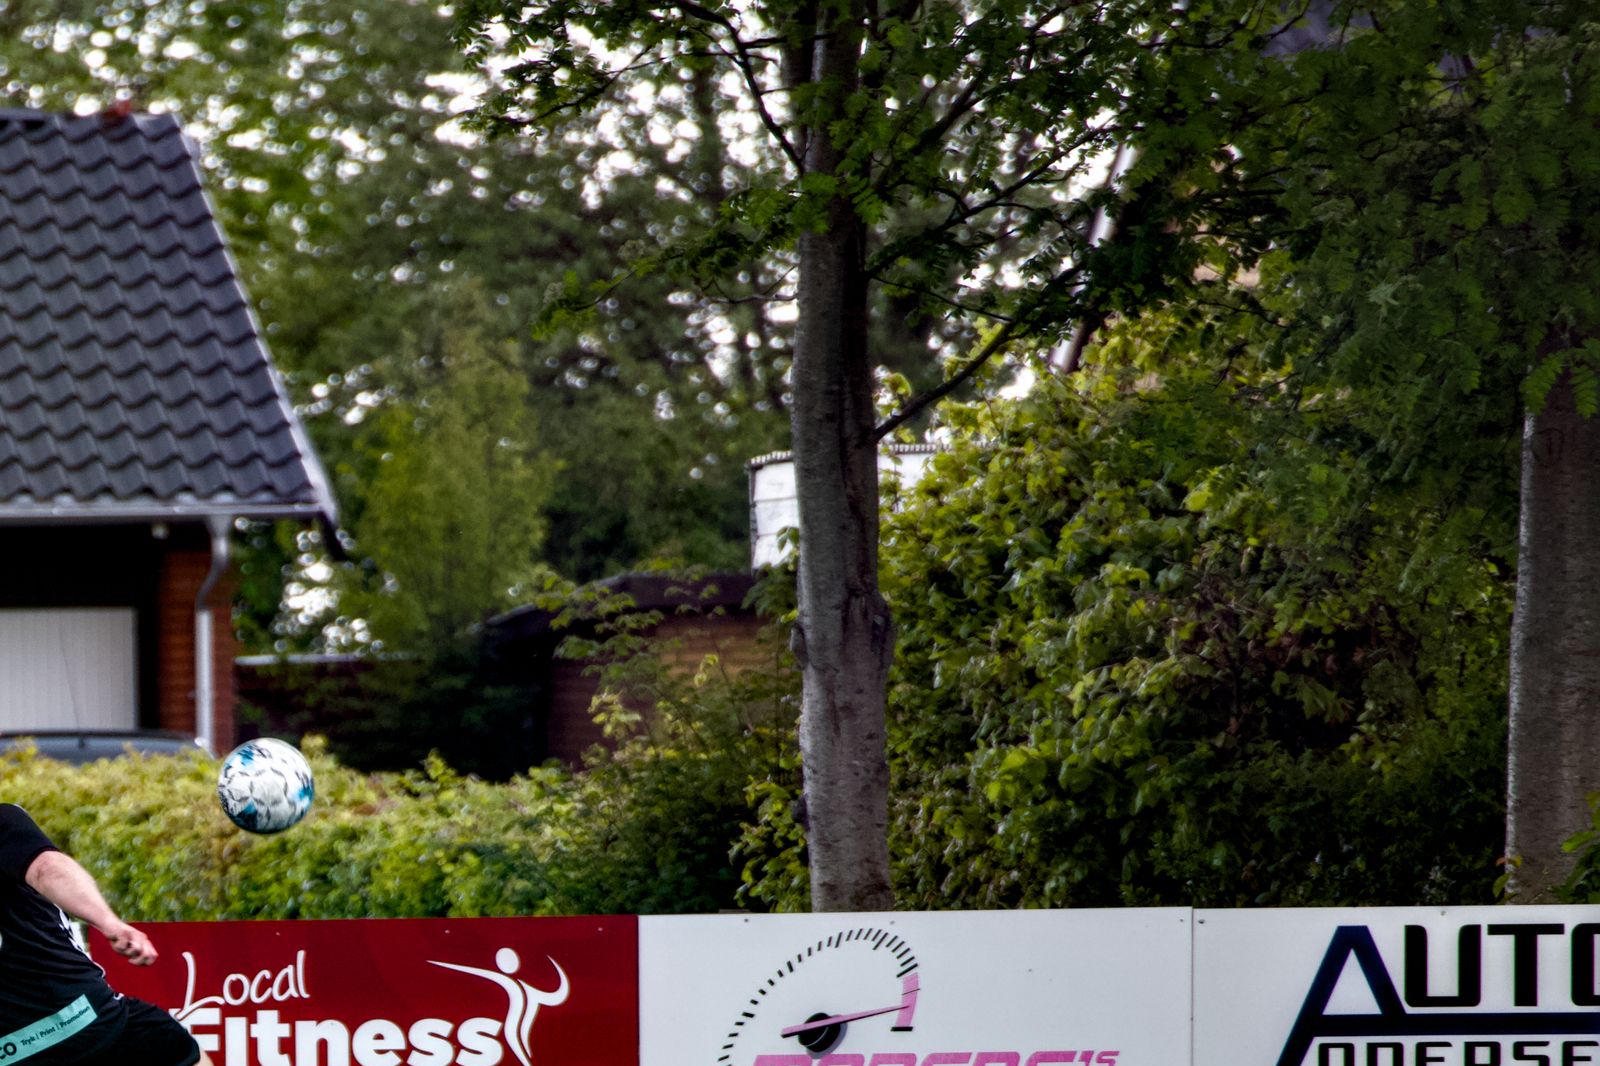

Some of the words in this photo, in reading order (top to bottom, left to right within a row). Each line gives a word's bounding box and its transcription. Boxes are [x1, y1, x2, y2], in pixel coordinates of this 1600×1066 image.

[176, 949, 310, 1021] Local
[20, 1035, 36, 1046] Tryk
[39, 1026, 56, 1038] Print
[59, 1006, 90, 1029] Promotion
